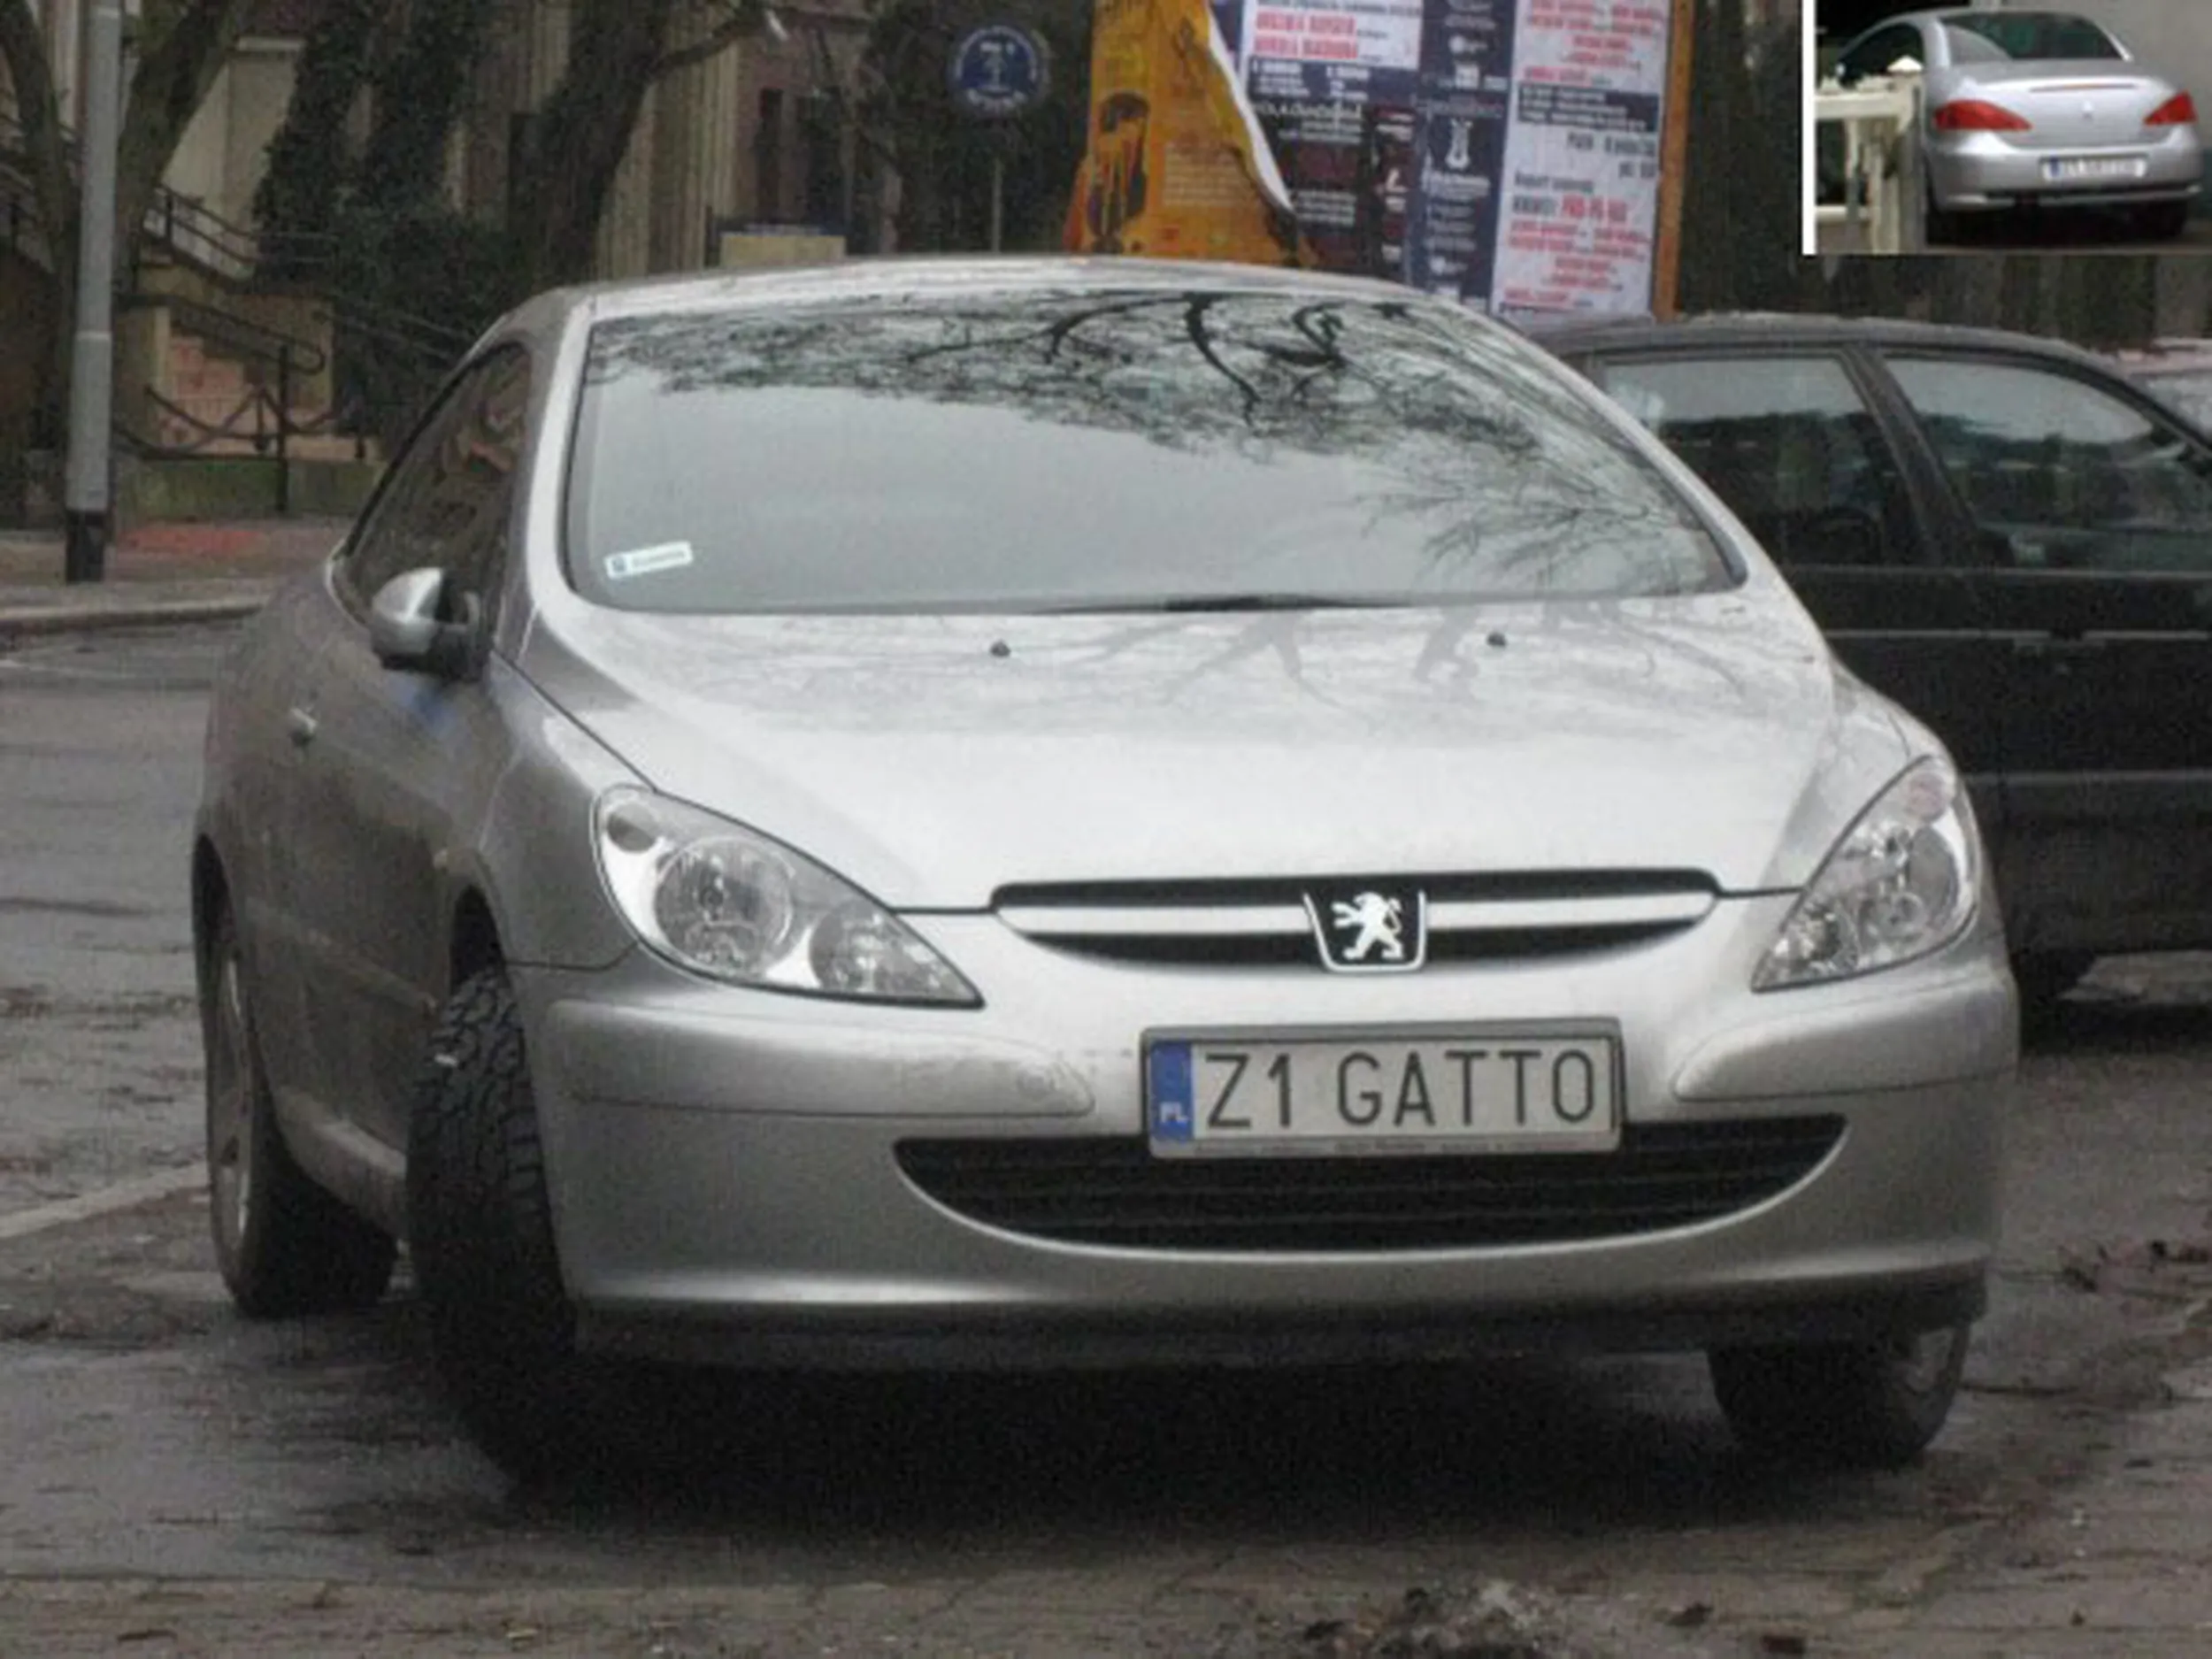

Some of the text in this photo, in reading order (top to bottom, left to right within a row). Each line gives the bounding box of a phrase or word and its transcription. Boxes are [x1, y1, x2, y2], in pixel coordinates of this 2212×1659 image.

[1160, 1102, 1188, 1123] PL
[1205, 1048, 1594, 1129] Z1 GATTO
